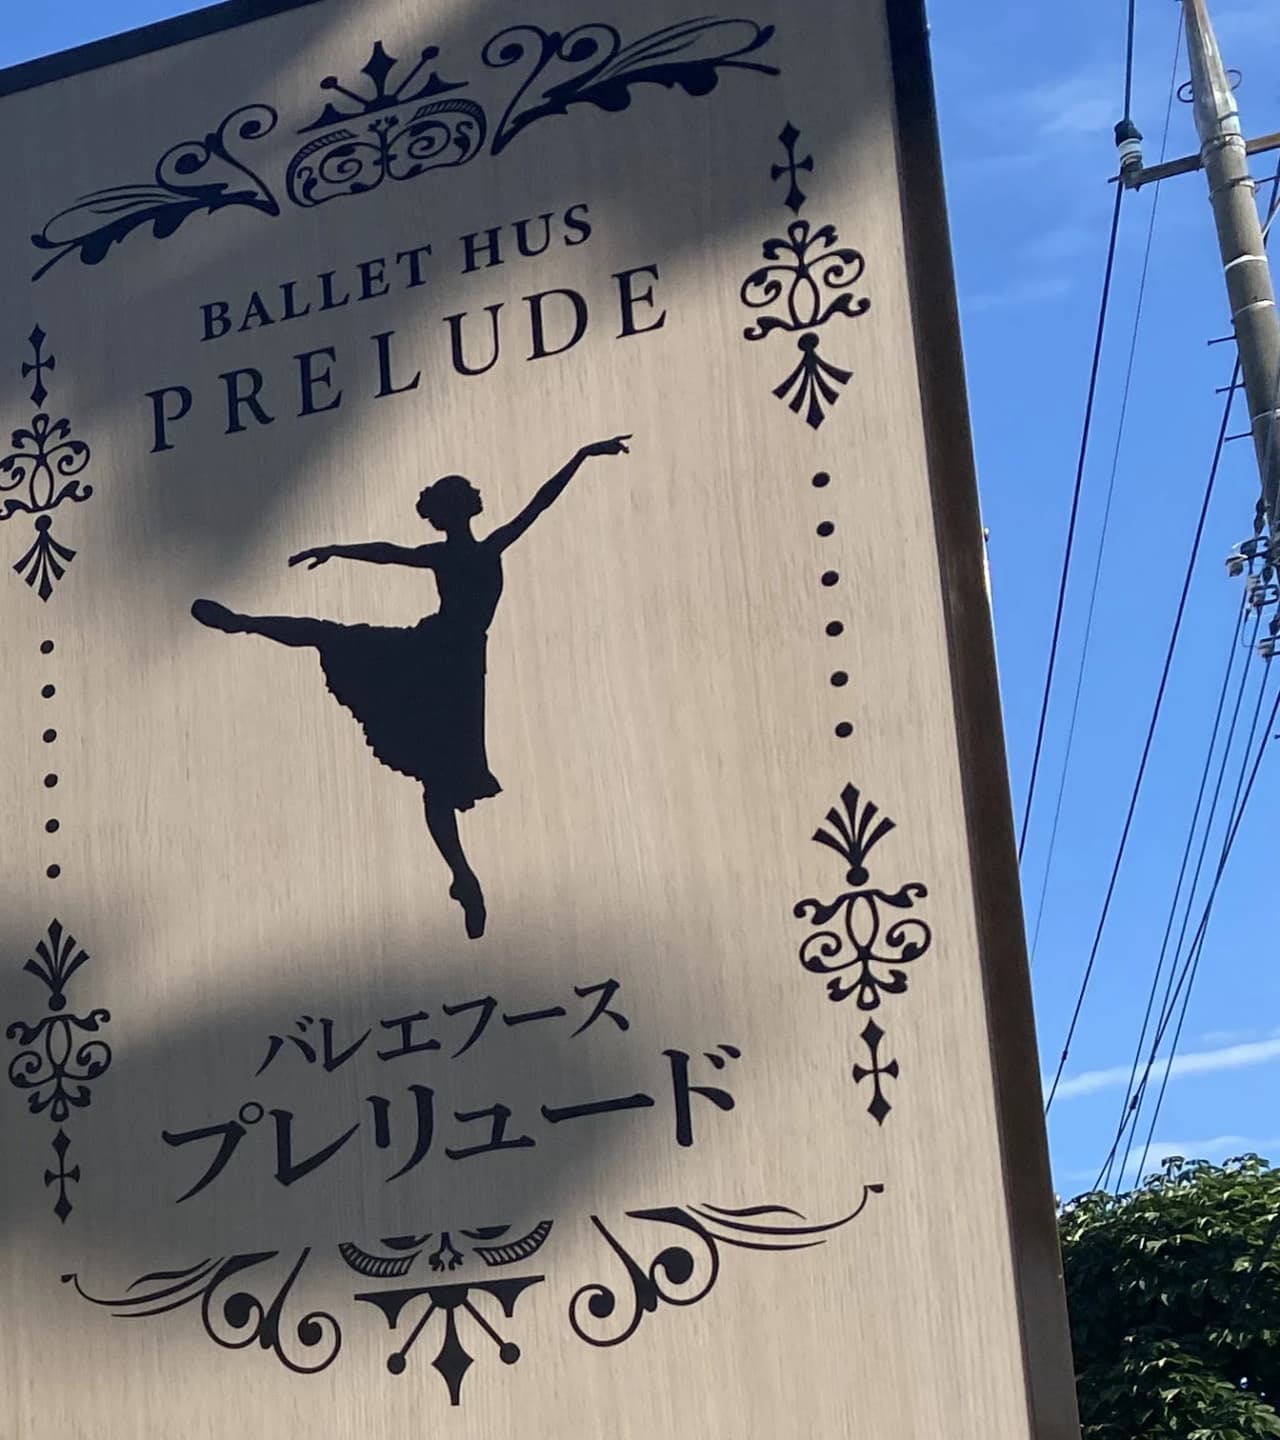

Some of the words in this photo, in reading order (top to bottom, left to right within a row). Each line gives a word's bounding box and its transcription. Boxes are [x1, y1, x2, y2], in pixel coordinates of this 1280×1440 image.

[198, 243, 433, 343] BALLET
[457, 203, 593, 275] HUS
[144, 263, 668, 455] PRELUDE
[255, 977, 631, 1077] バレエフース
[160, 1043, 742, 1204] プレリュード
